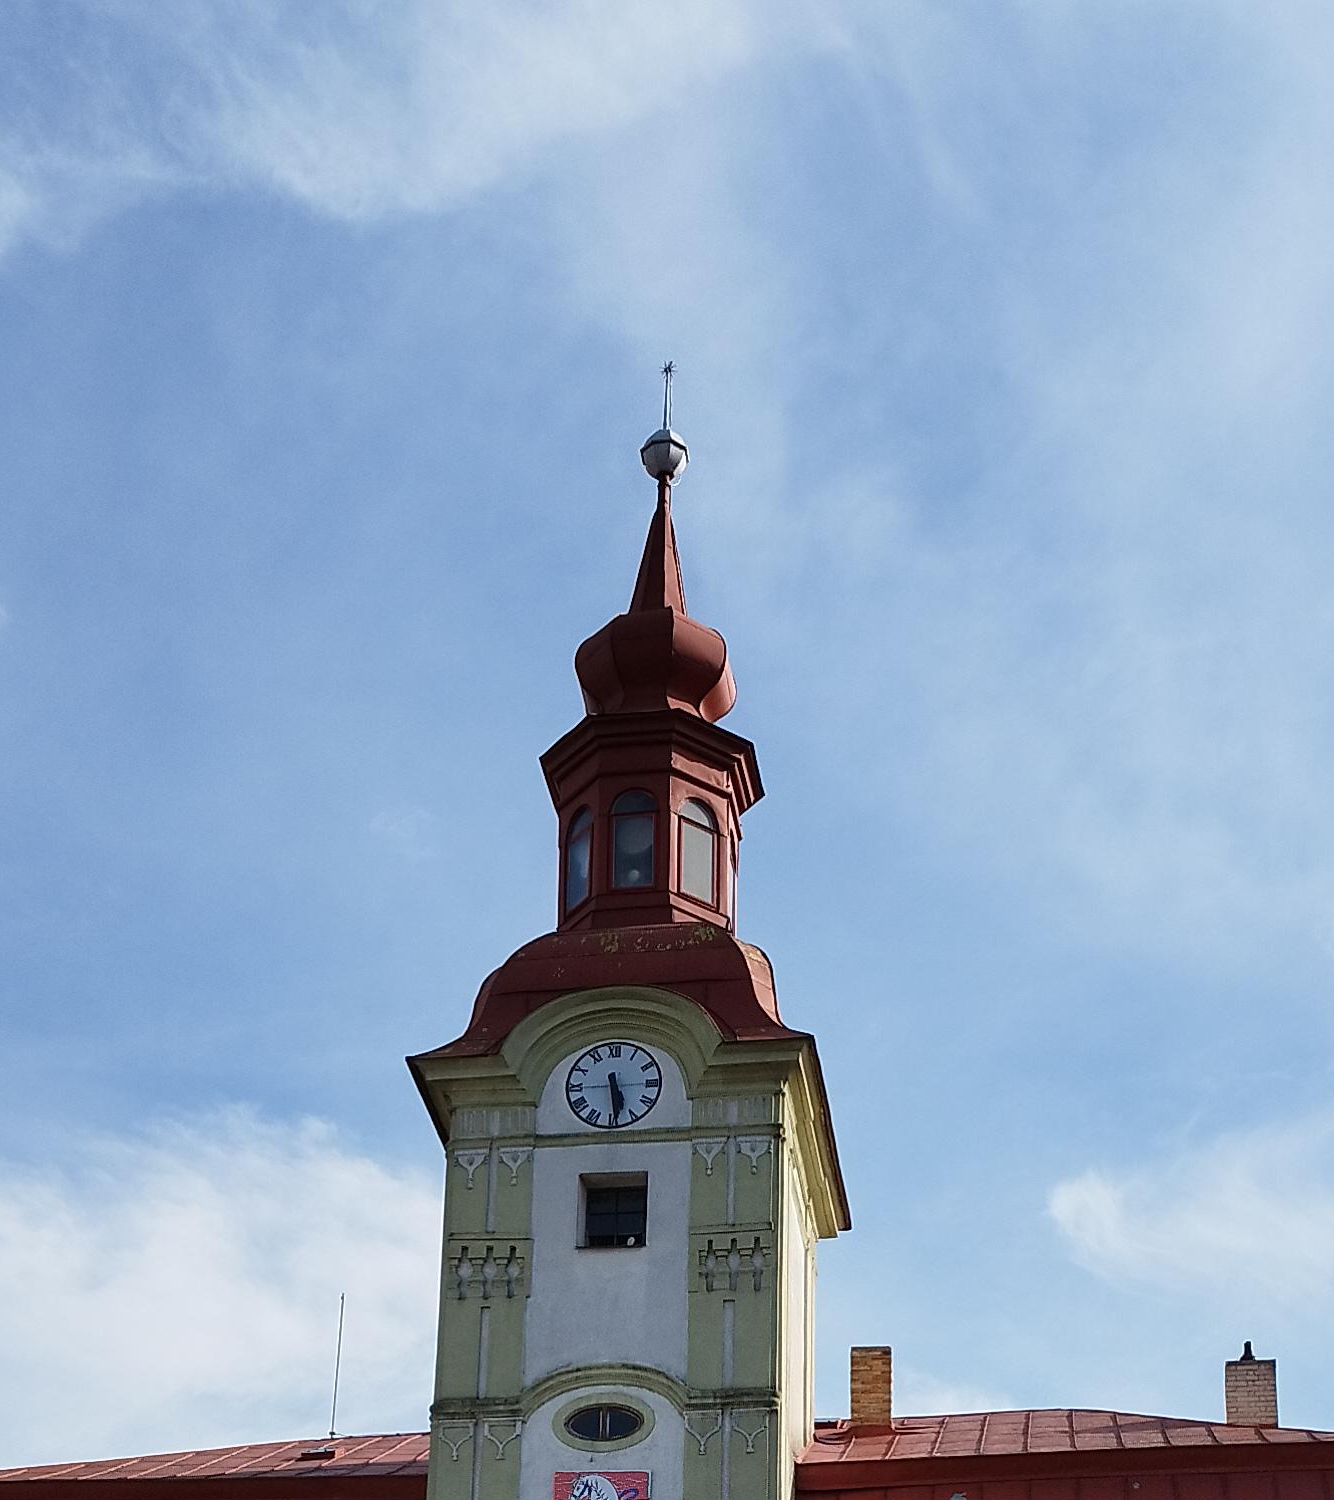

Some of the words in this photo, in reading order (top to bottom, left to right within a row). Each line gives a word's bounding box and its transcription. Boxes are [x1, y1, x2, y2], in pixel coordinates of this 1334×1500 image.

[589, 1050, 603, 1064] XI
[608, 1045, 622, 1058] XII
[630, 1048, 639, 1061] I
[574, 1066, 588, 1076] X
[640, 1061, 654, 1072] II
[570, 1083, 583, 1092] IX
[639, 1094, 654, 1108] IV
[586, 1108, 601, 1124] VII
[628, 1108, 639, 1121] V
